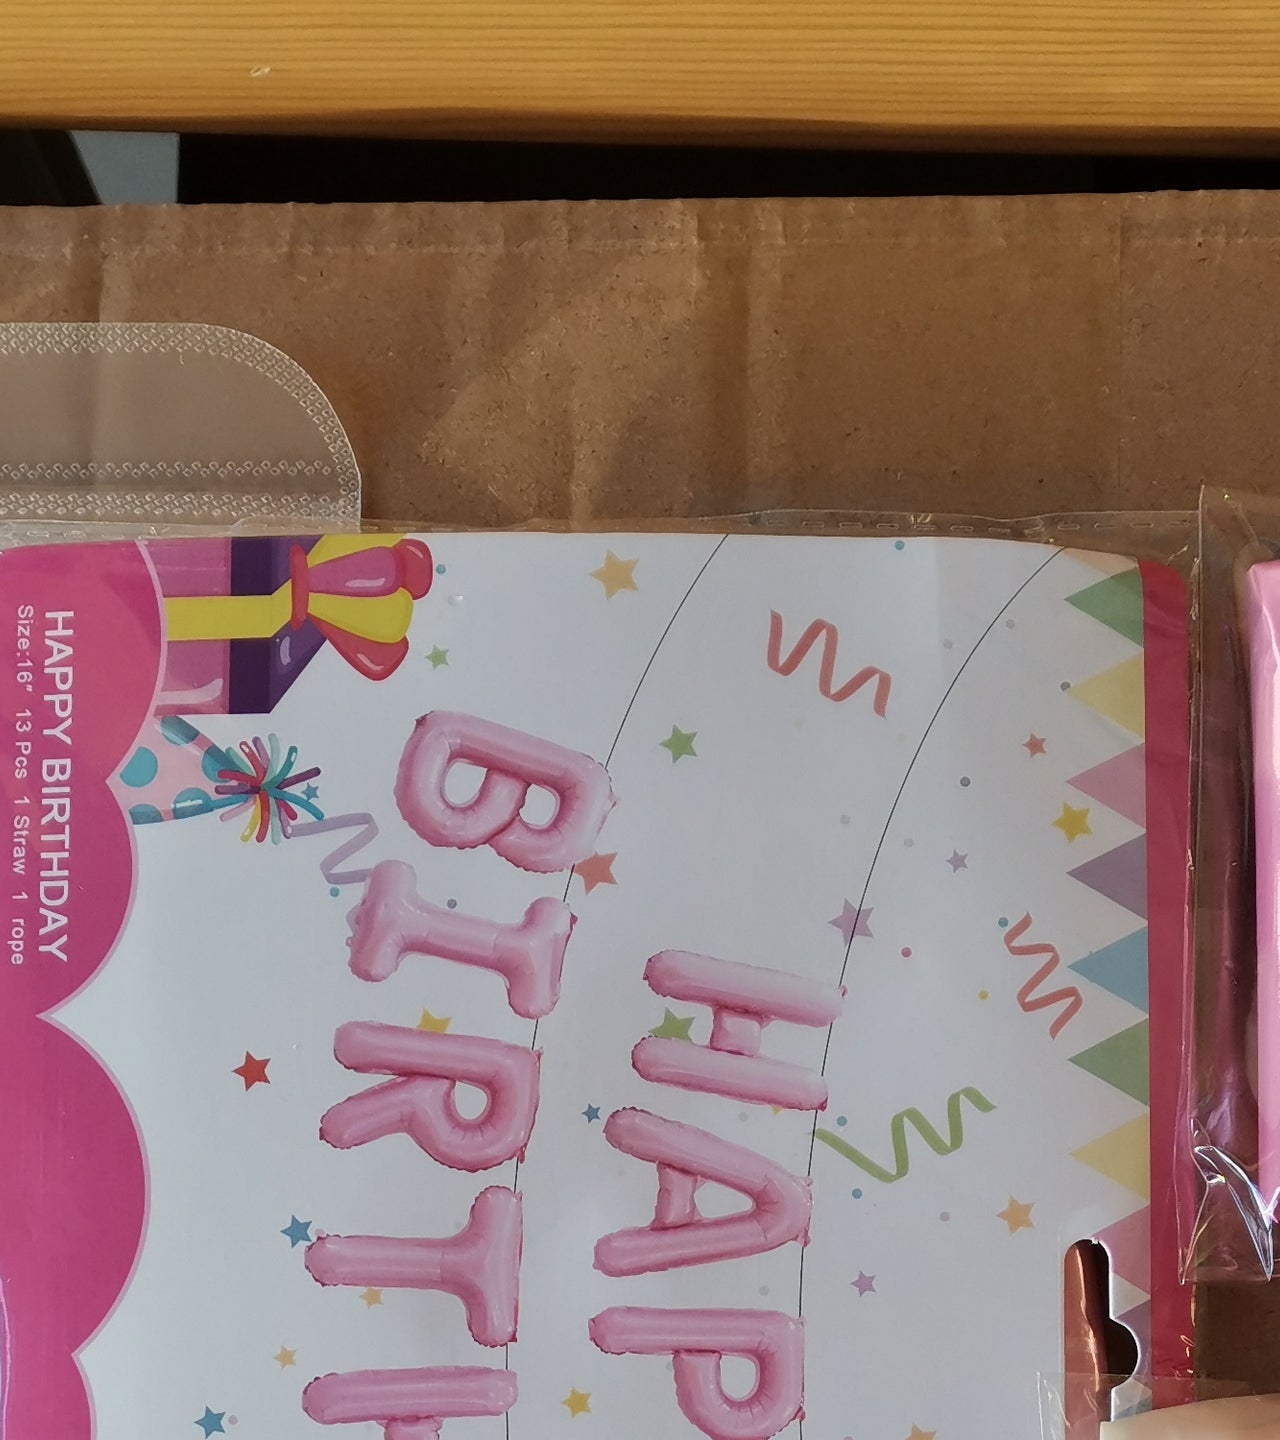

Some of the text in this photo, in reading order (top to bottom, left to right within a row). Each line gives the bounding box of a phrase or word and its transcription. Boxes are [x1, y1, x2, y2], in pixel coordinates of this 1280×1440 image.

[15, 709, 32, 732] 13
[14, 796, 29, 804] 1
[38, 610, 74, 962] HAPPY BIRTHDAY
[13, 815, 30, 875] Straw
[11, 891, 28, 899] 1
[7, 918, 25, 965] rope
